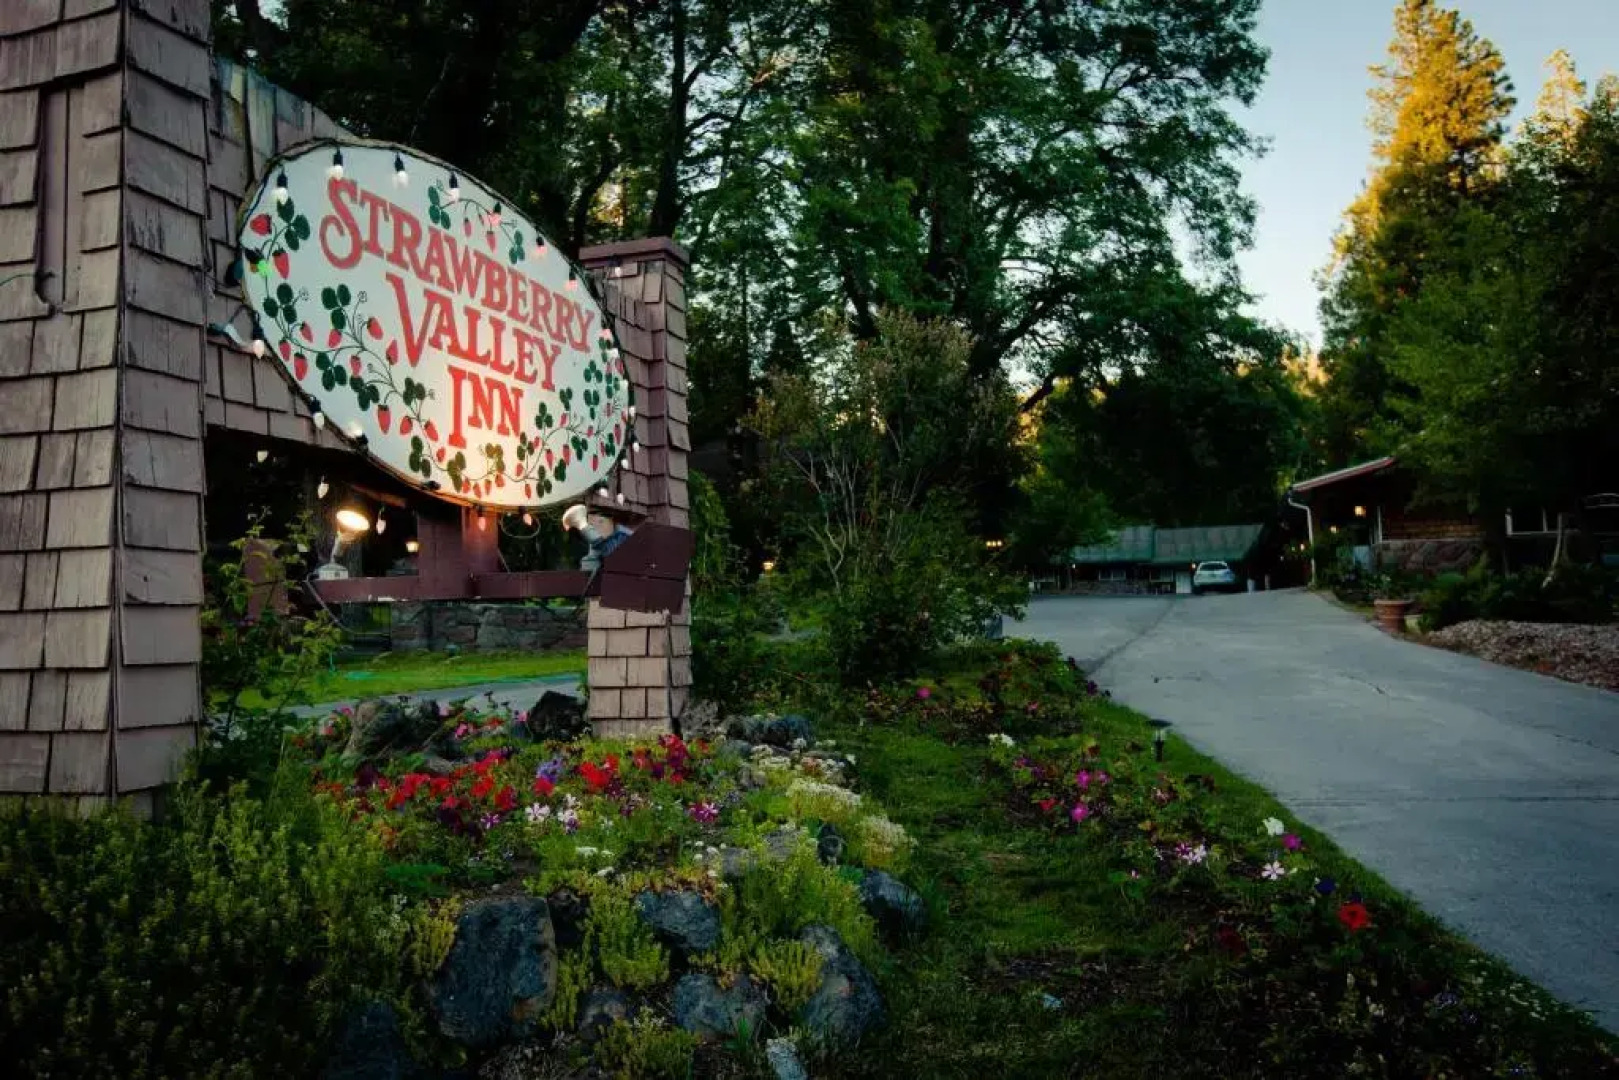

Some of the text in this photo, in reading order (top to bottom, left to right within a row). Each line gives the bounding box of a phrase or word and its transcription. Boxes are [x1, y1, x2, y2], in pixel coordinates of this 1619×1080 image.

[320, 178, 594, 351] STRAWBERRY
[387, 274, 561, 391] VALLEY
[448, 367, 523, 448] INN
